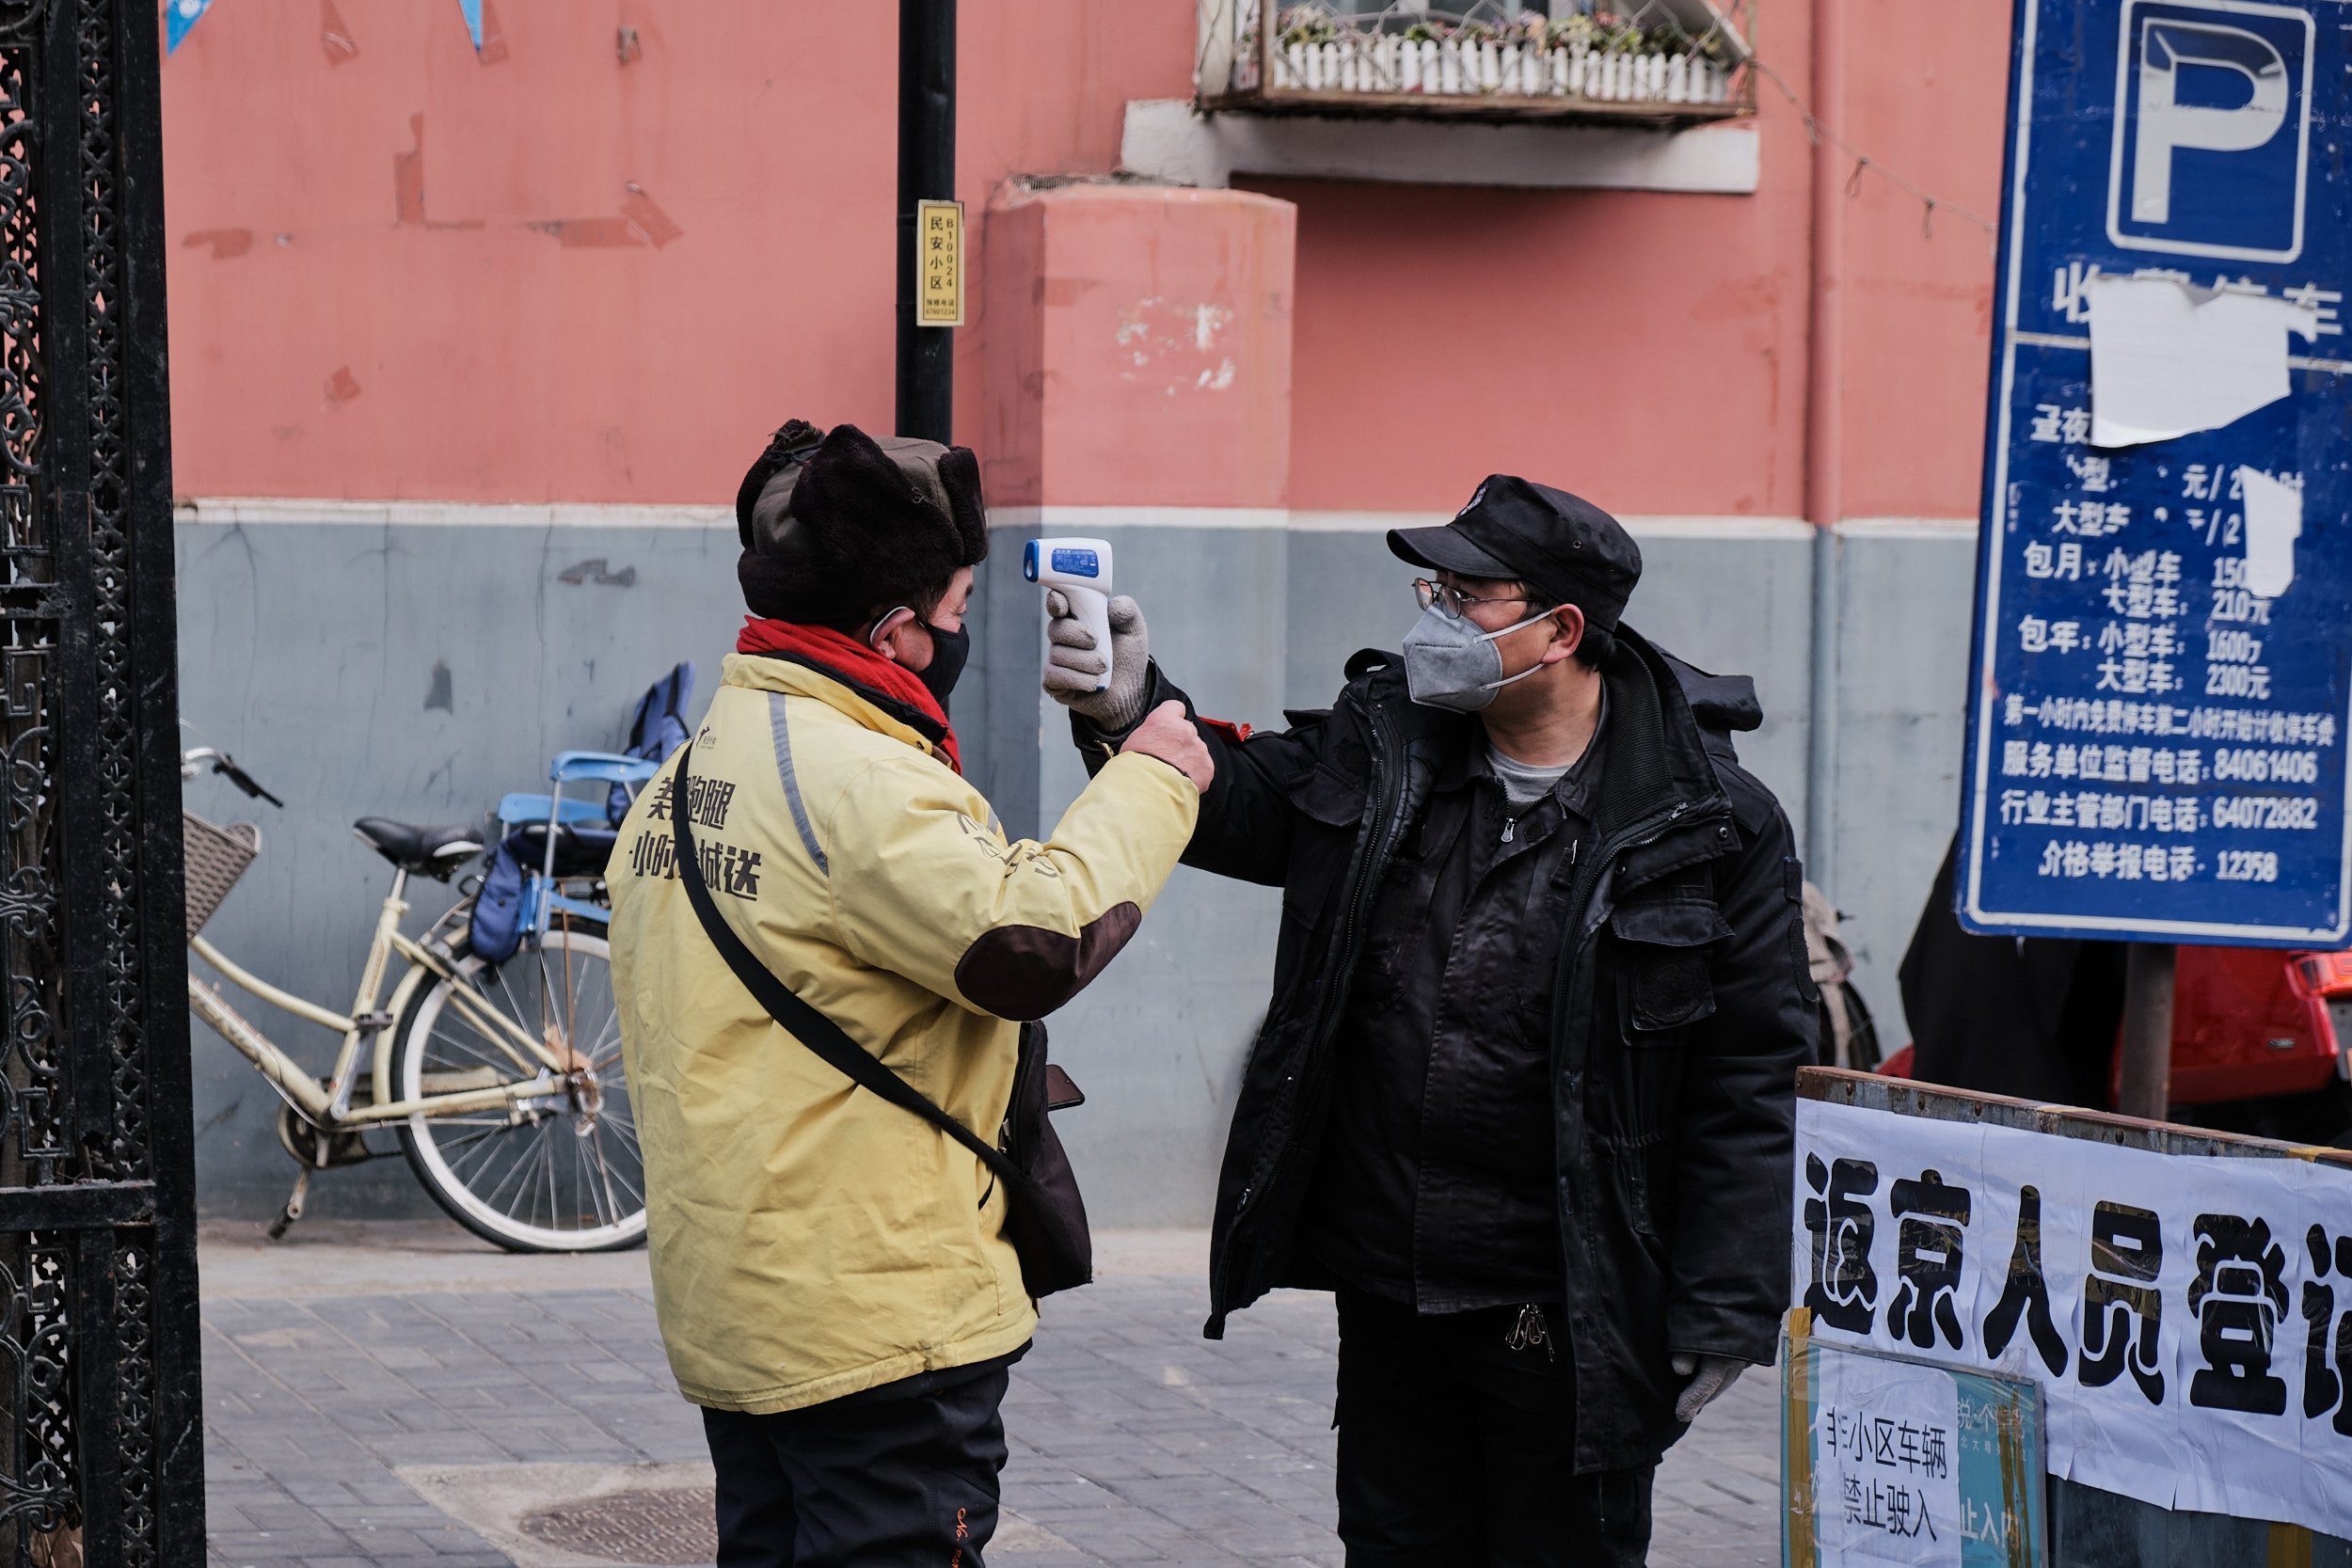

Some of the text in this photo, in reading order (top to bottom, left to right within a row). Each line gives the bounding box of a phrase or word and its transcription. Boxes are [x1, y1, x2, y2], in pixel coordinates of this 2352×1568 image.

[2132, 17, 2288, 224] P
[930, 216, 943, 290] 民安小区
[2052, 499, 2131, 537] 大型车
[2214, 748, 2318, 784] 84061406
[646, 775, 736, 830] 美跑腿
[2213, 796, 2318, 830] 64072882
[2217, 850, 2279, 882] 12358
[1827, 1406, 1947, 1480] 非小区车辆
[1843, 1472, 1937, 1542] 禁止驶入
